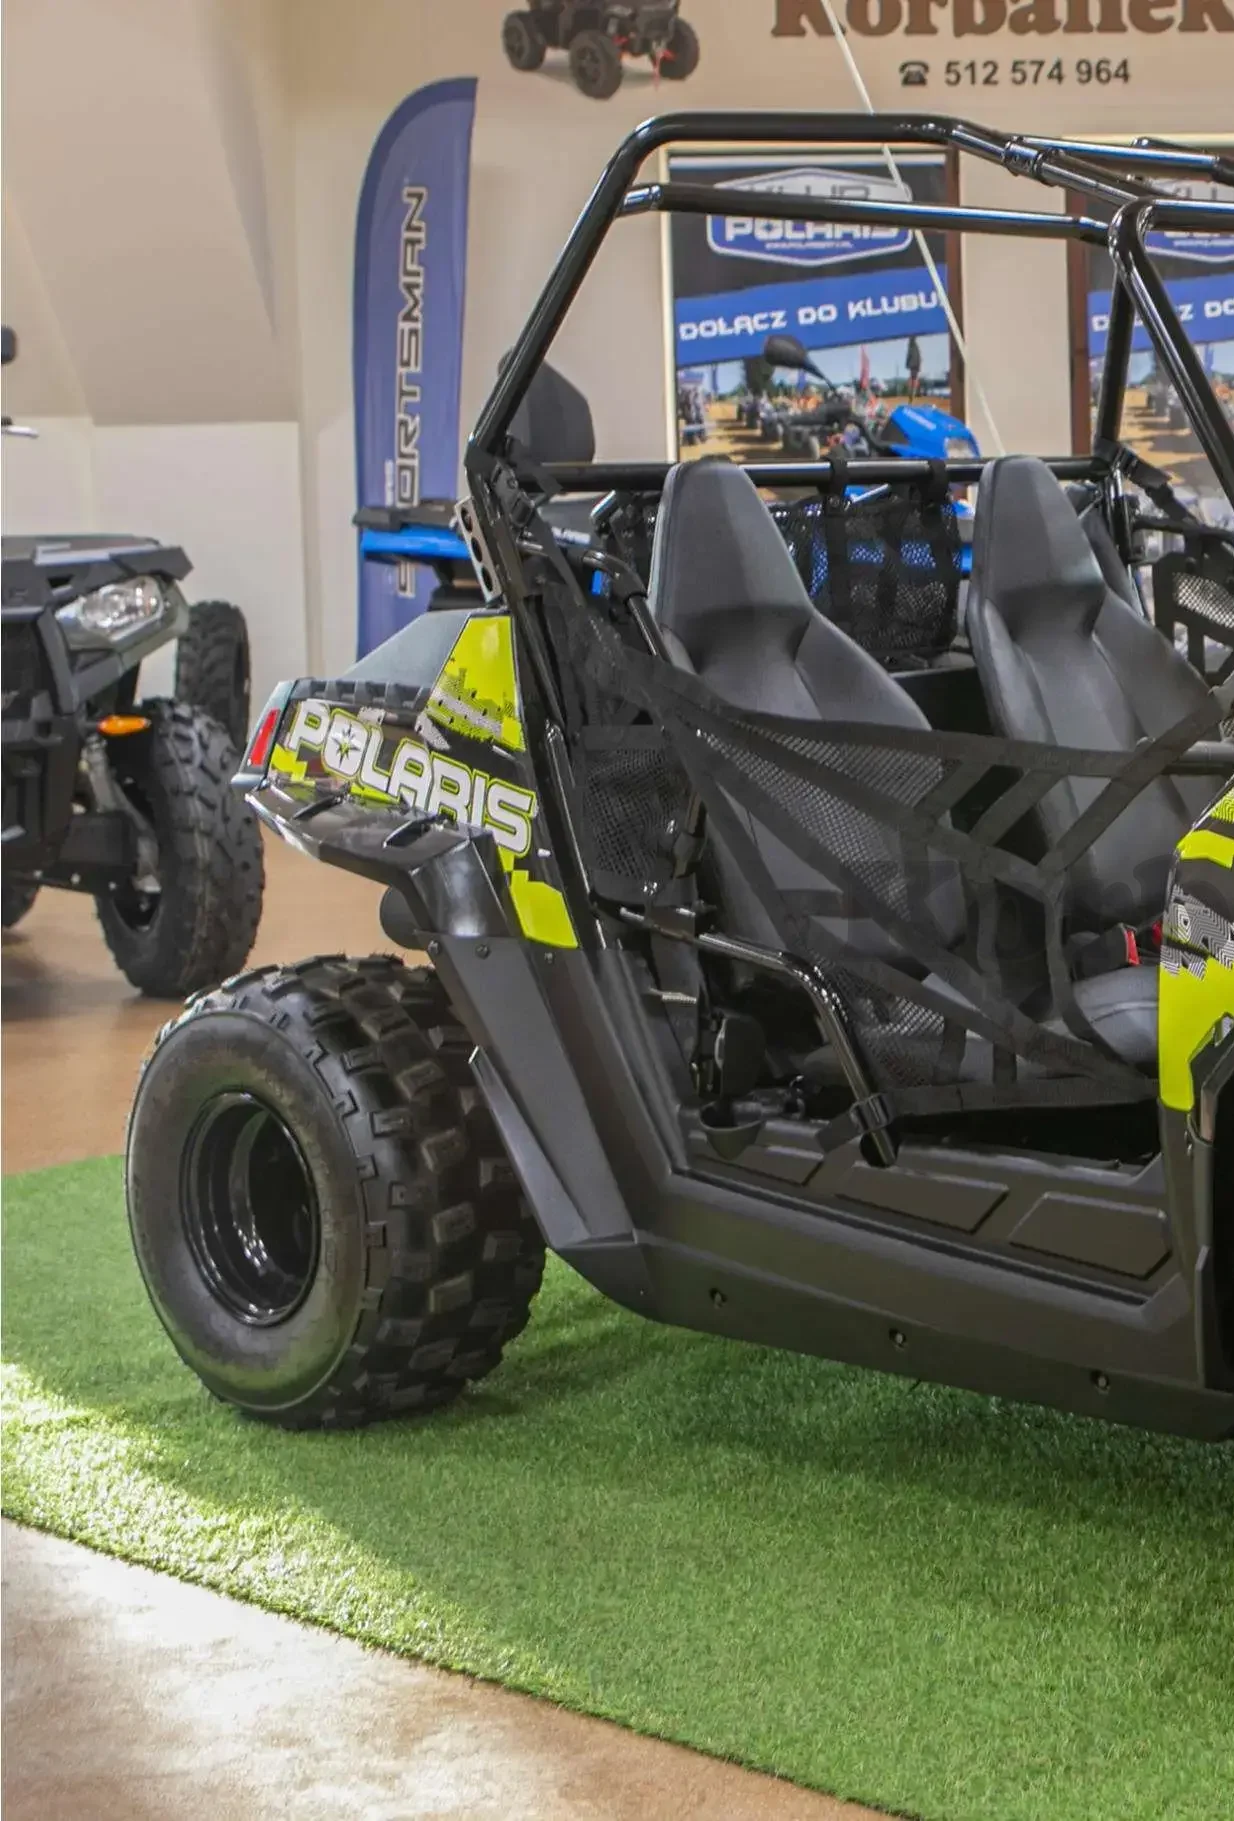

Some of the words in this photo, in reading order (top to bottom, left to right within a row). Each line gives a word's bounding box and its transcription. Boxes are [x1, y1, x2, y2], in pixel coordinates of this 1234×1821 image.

[944, 60, 999, 86] 512
[1011, 58, 1065, 85] 574
[1075, 58, 1131, 85] 964
[798, 304, 837, 325] DO
[395, 186, 428, 599] SORTSMAN
[286, 700, 539, 856] POLARIS
